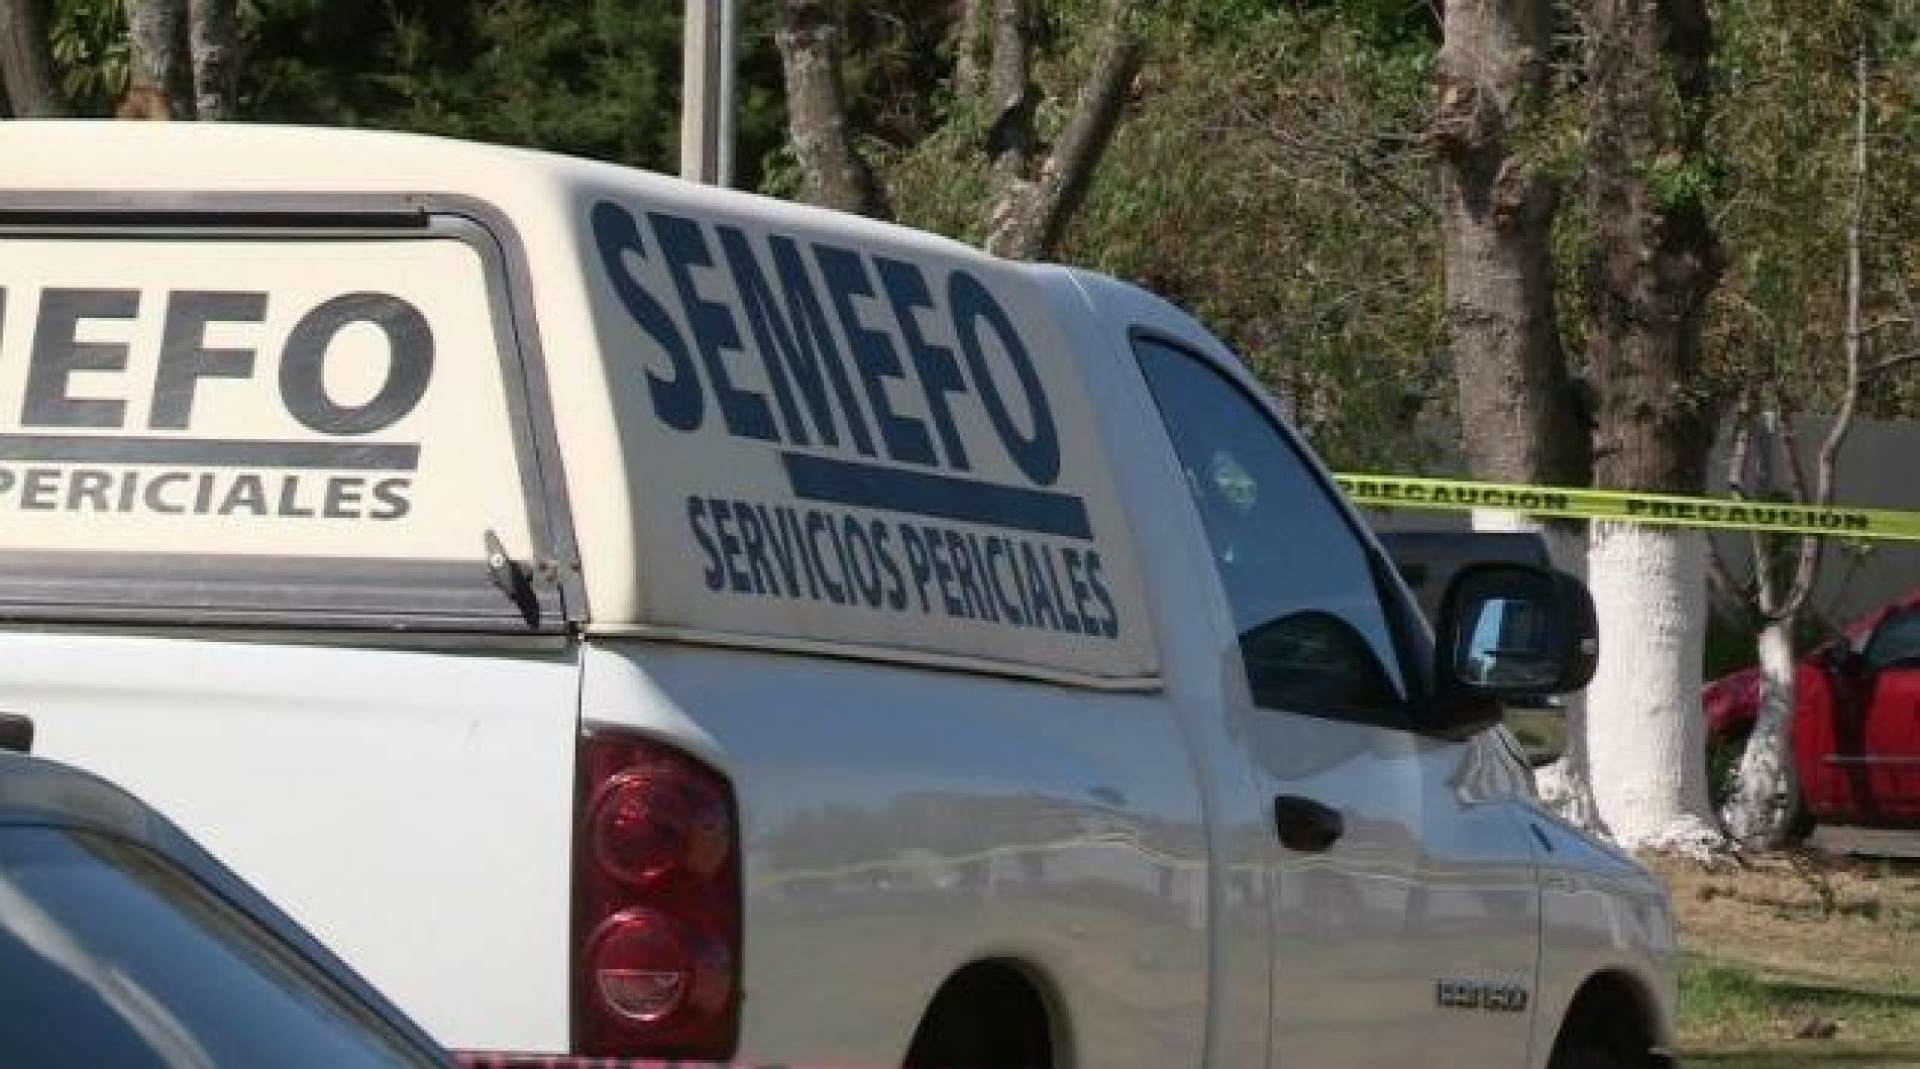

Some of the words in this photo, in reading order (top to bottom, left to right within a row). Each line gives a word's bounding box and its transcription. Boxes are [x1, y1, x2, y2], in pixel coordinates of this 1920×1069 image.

[0, 286, 436, 437] EFO
[591, 202, 1060, 486] SEMEFO
[687, 495, 908, 612] SERVICIOS
[899, 523, 1118, 639] PERICIALES
